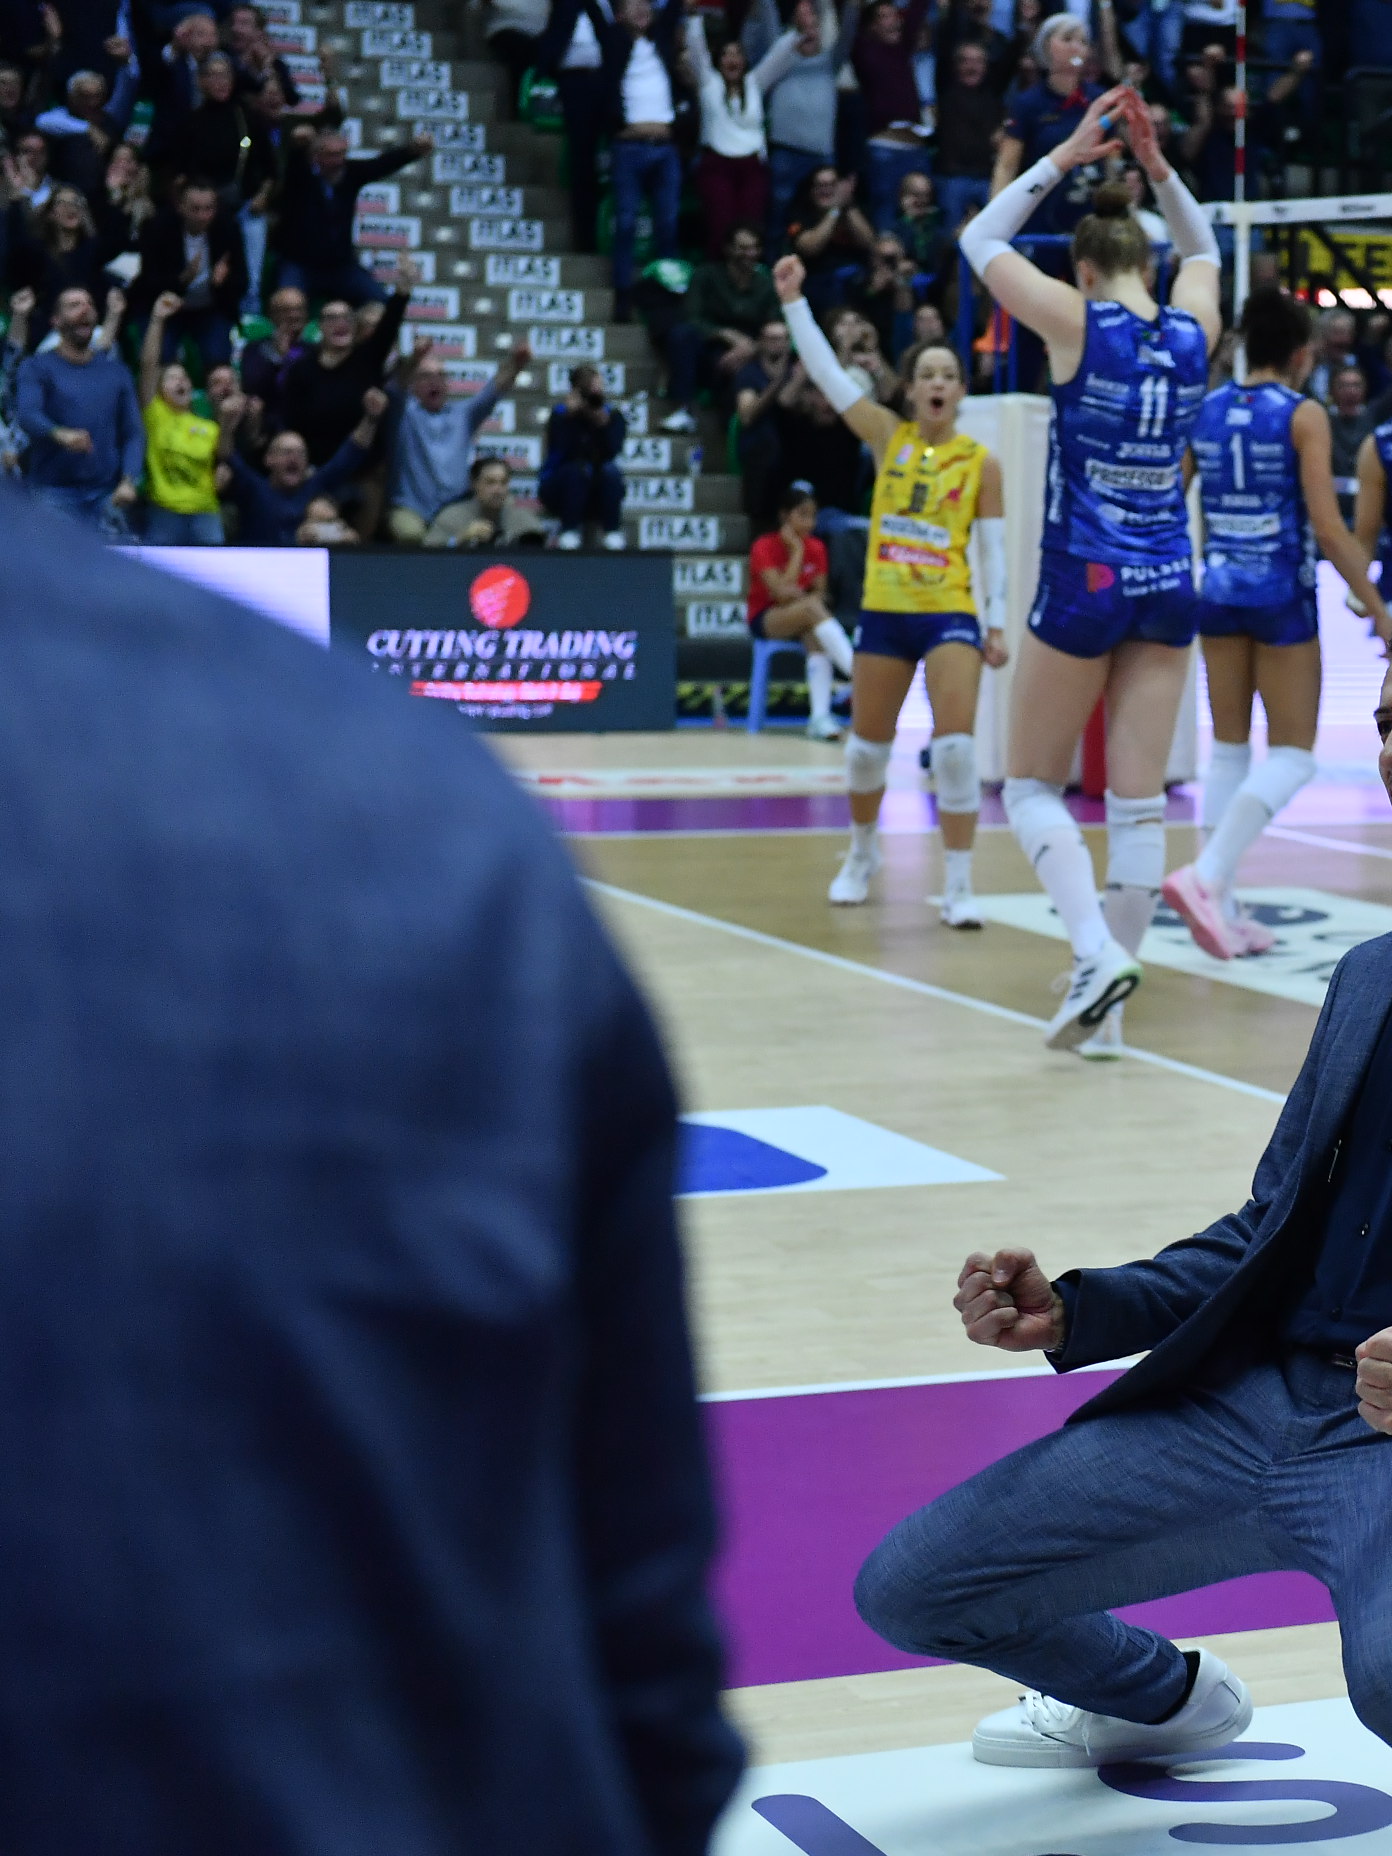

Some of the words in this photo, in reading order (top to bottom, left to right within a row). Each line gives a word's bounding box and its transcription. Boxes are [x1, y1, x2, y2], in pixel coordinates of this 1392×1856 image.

[1136, 375, 1169, 438] 11
[1230, 432, 1245, 490] 1
[628, 480, 683, 500] TLAS
[646, 517, 706, 538] ITLAS
[679, 563, 733, 583] TLAS
[694, 604, 745, 625] ITLA
[366, 628, 501, 661] CUTTING
[503, 629, 639, 661] TRADING
